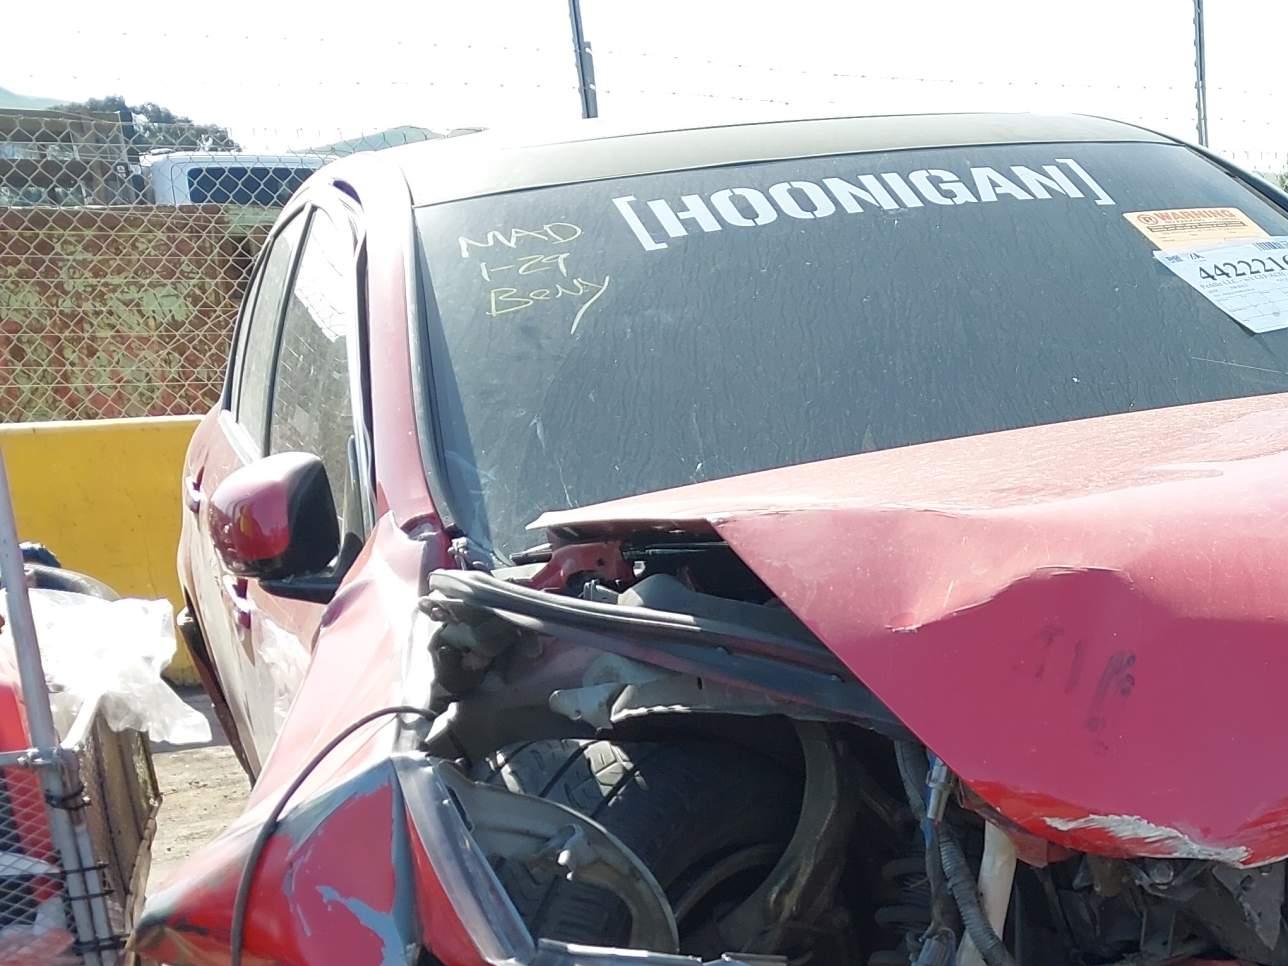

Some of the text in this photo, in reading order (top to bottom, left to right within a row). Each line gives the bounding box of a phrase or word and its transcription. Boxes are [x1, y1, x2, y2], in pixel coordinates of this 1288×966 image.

[1154, 209, 1236, 222] WARNING
[457, 222, 583, 259] MAD
[480, 252, 571, 282] 1-29
